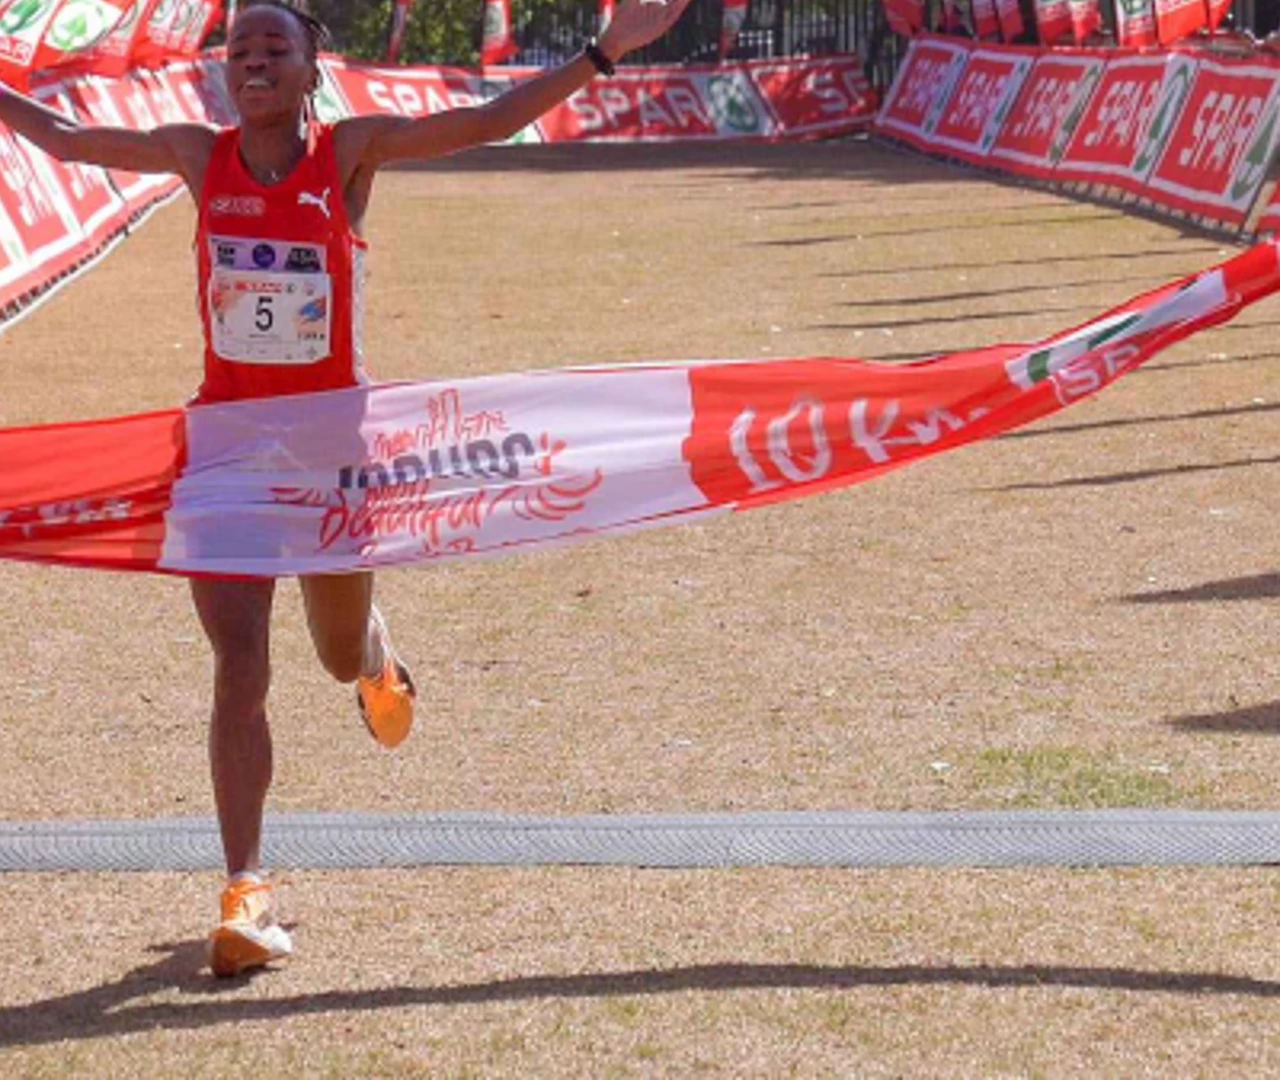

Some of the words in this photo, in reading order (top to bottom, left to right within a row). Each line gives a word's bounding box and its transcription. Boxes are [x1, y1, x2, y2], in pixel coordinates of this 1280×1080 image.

[567, 90, 708, 130] SPAR
[255, 296, 273, 331] 5
[729, 394, 833, 492] 10
